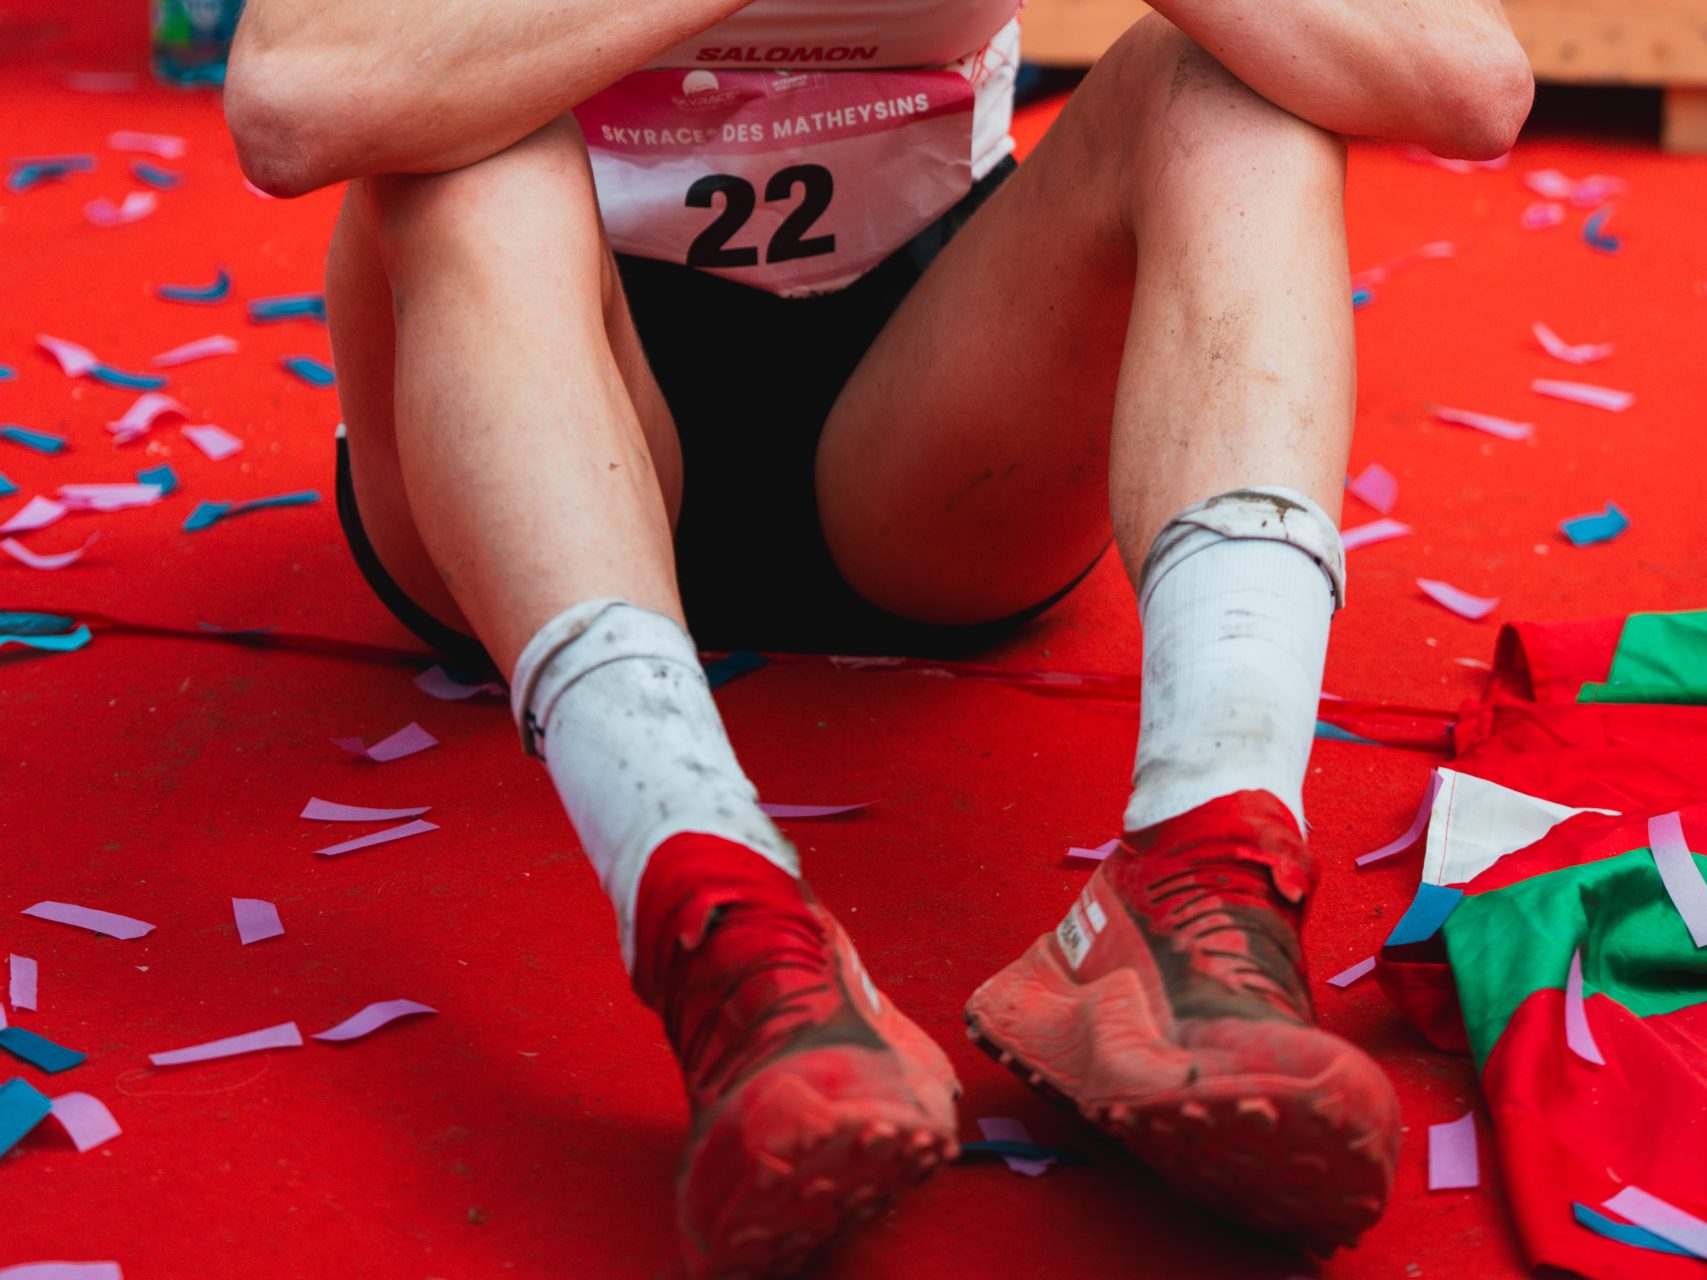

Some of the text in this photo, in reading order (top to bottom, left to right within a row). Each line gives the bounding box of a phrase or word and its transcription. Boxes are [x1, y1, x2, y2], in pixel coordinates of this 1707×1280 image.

[696, 46, 879, 62] SALOMON
[601, 93, 929, 145] SKYRACE DES MATHEYSINS
[684, 163, 836, 269] 22
